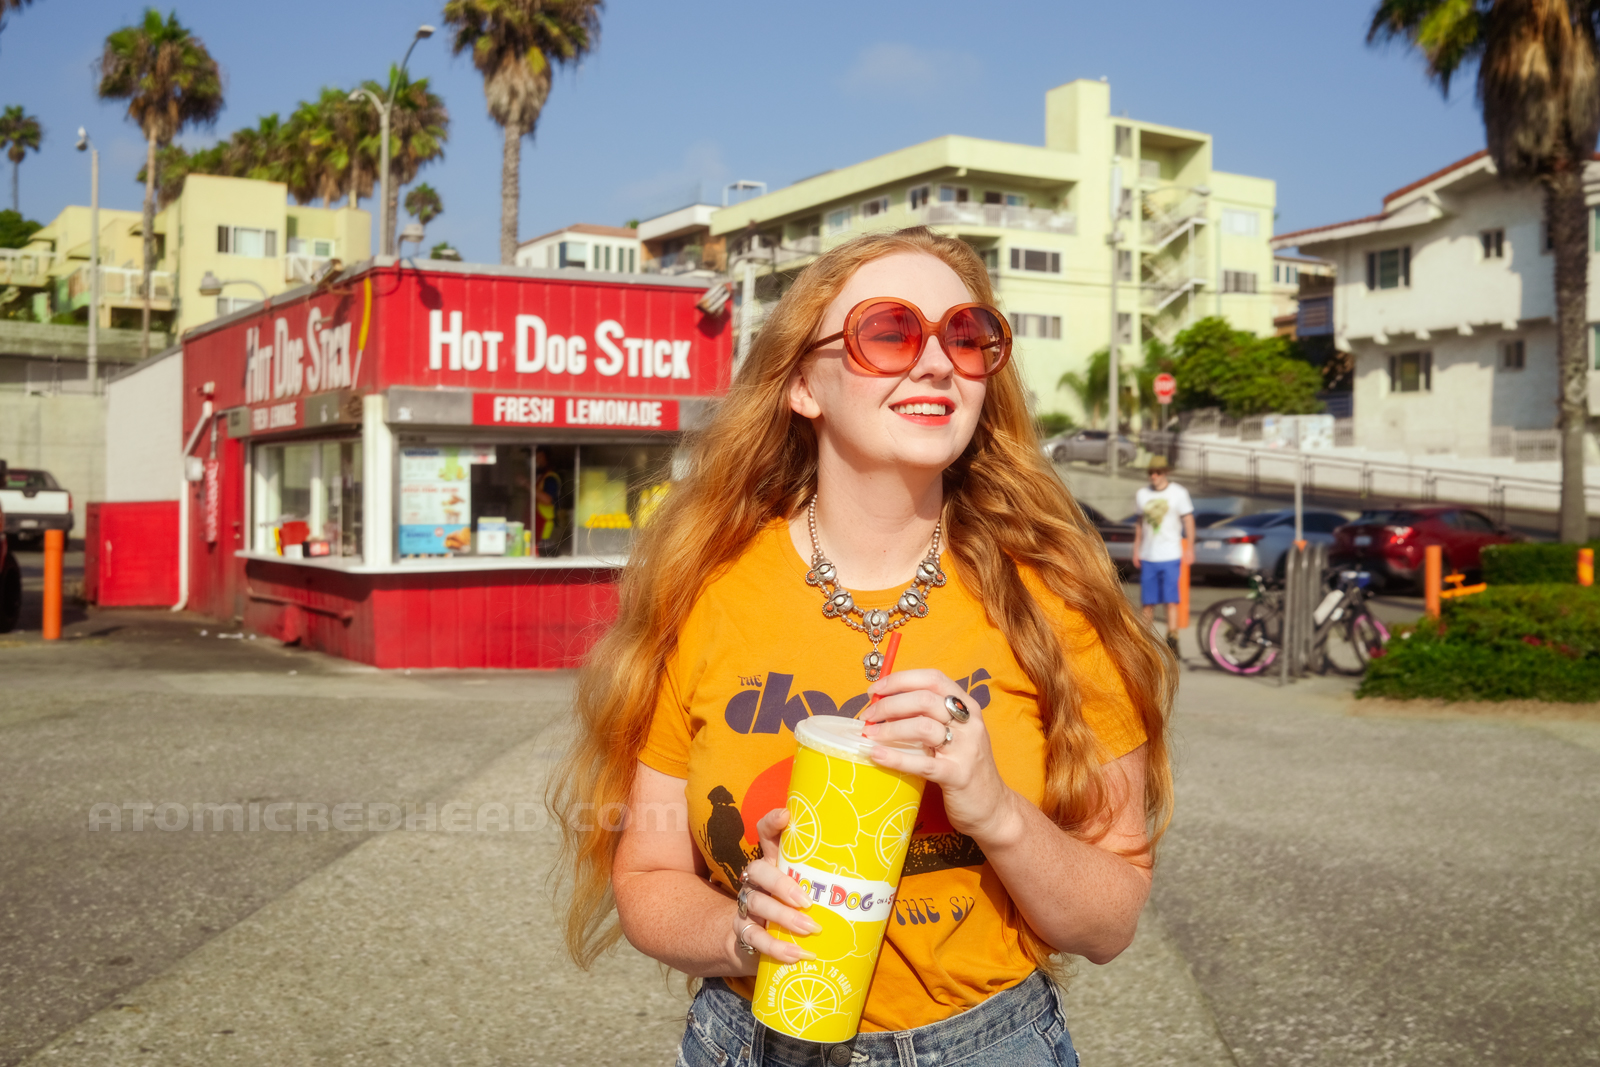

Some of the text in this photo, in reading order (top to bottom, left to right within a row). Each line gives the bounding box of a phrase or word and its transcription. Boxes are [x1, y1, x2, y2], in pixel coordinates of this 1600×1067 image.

[429, 309, 692, 379] HOT DOG STICK
[493, 396, 662, 427] FRESH LEMONADE
[737, 674, 763, 688] THE
[828, 883, 874, 912] DOG
[893, 897, 940, 926] THE
[803, 961, 818, 973] for
[827, 966, 839, 979] 75
[836, 973, 853, 996] YEARS
